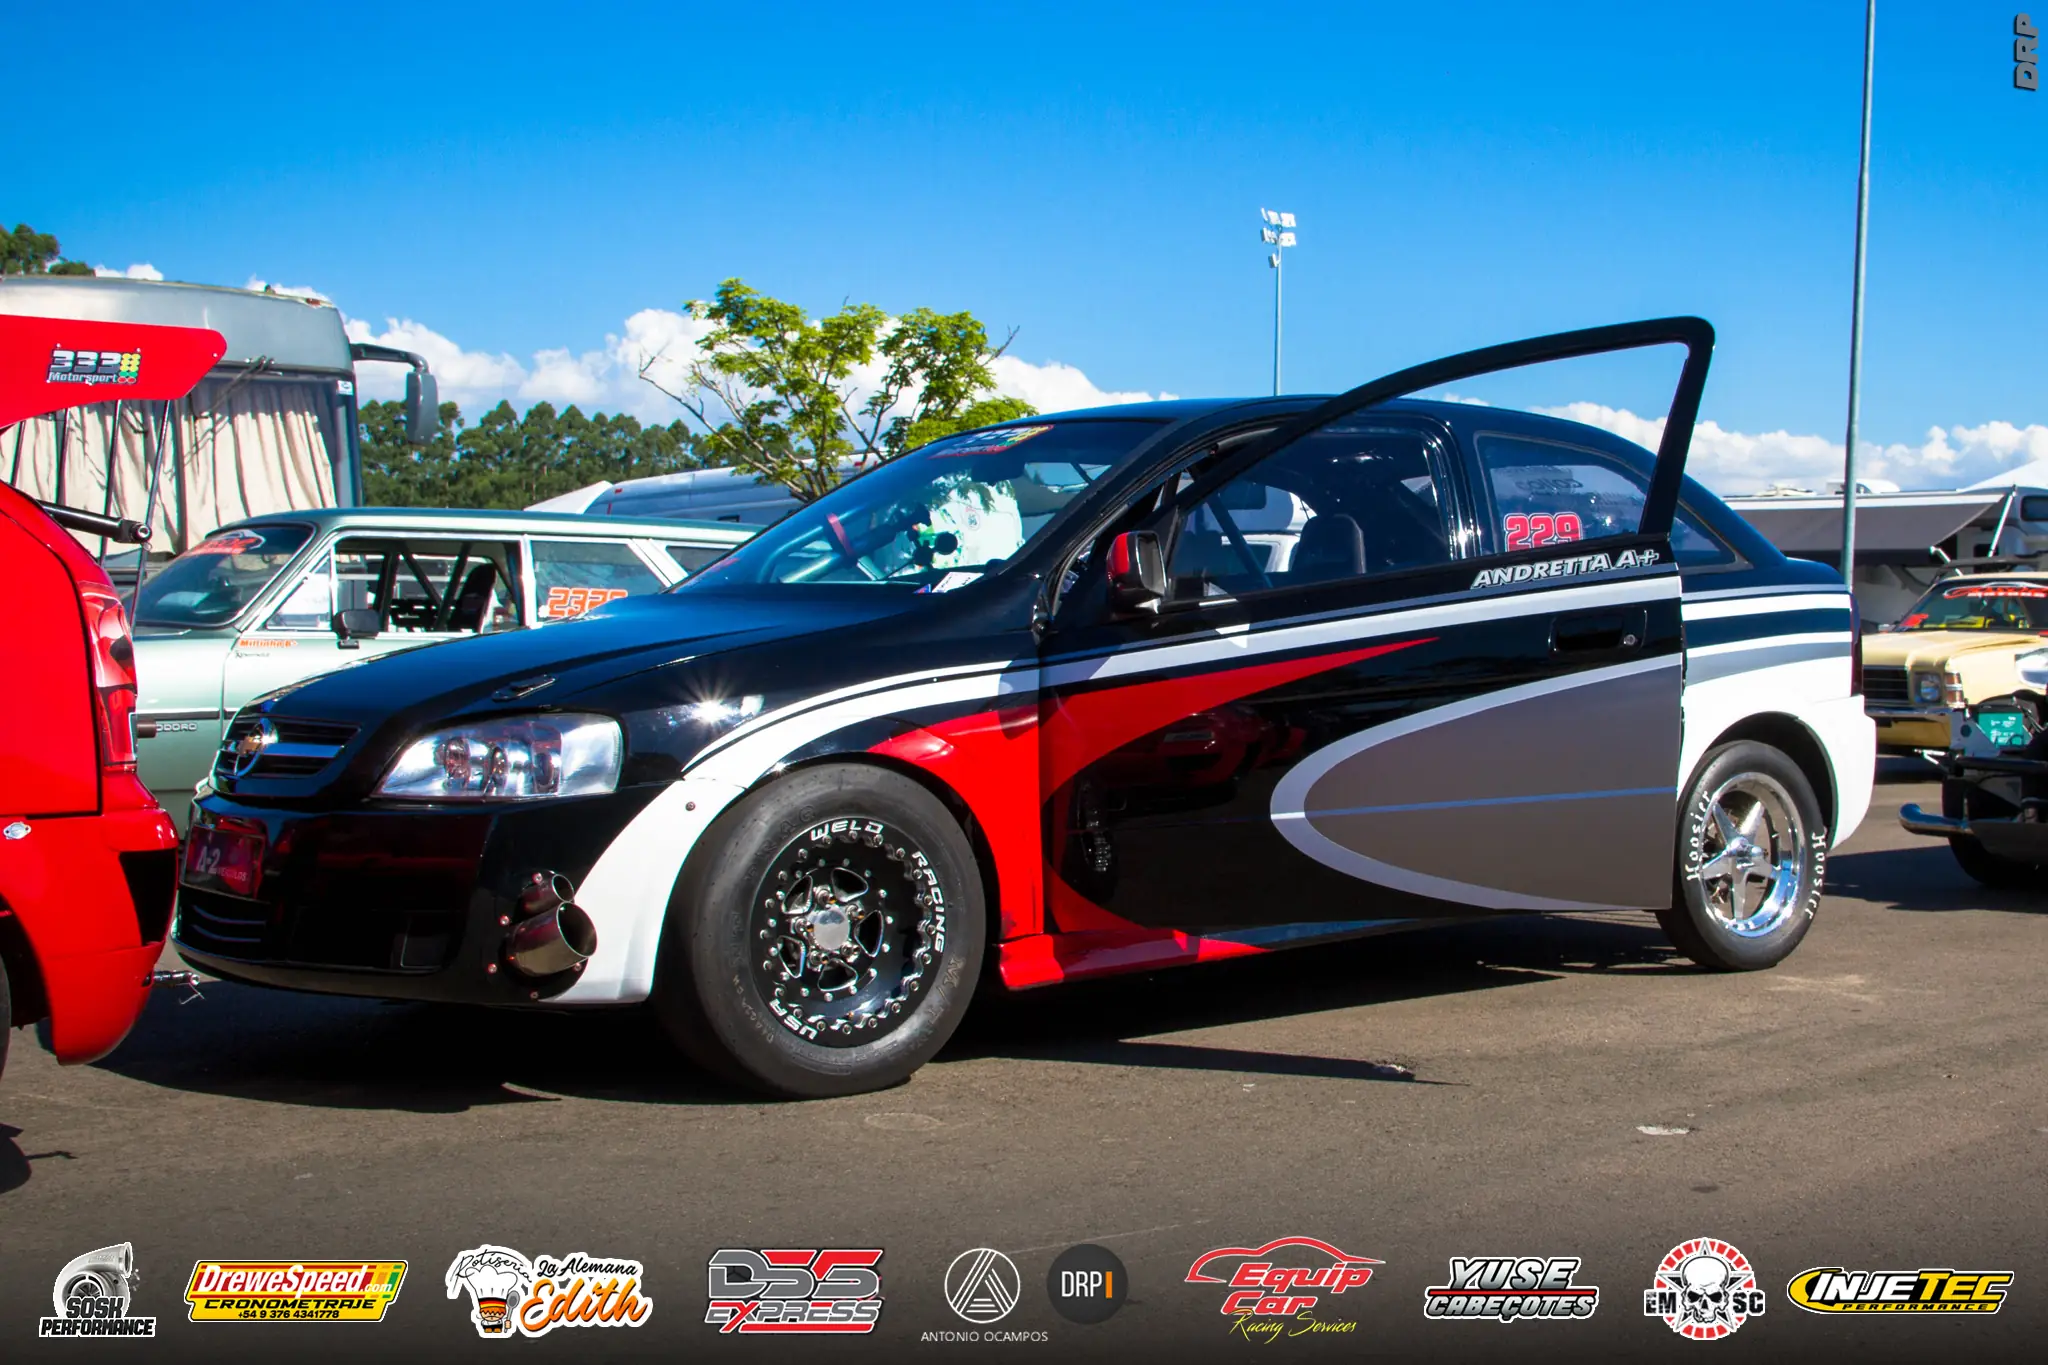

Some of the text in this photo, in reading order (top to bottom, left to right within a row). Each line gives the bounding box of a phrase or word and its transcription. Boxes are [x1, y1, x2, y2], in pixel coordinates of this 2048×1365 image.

[48, 371, 118, 383] Motorsport
[1504, 511, 1583, 552] 229
[1470, 549, 1660, 589] ANDRETTA A+
[1684, 790, 1711, 881] Hoosier
[811, 819, 946, 953] WELD RACING
[1804, 826, 1828, 919] Hoosier
[770, 998, 820, 1040] USA
